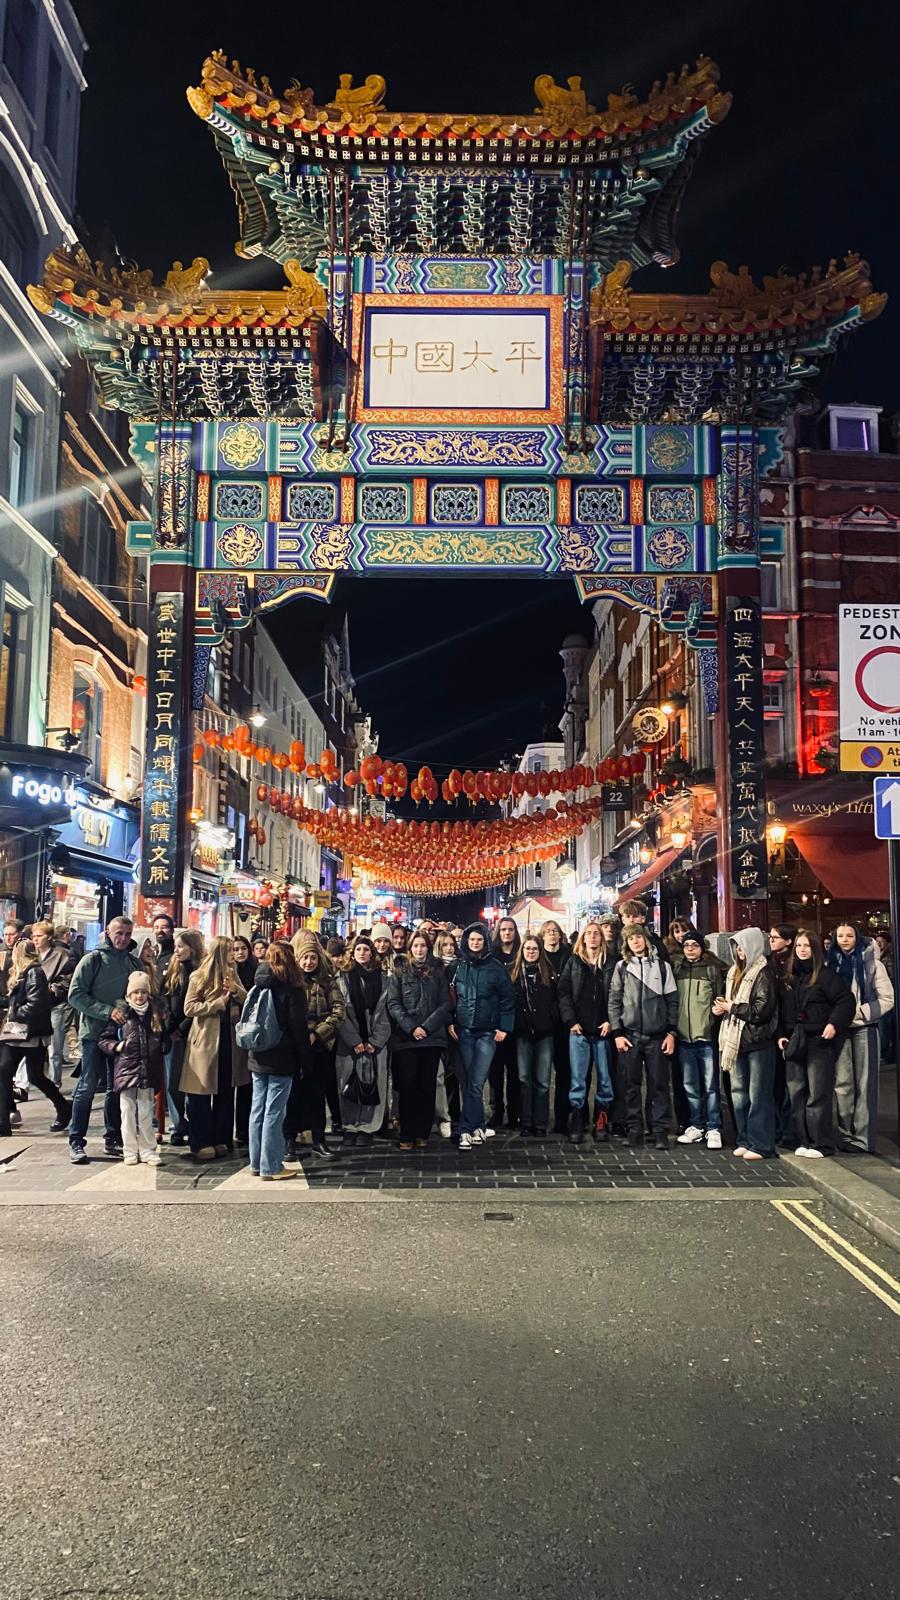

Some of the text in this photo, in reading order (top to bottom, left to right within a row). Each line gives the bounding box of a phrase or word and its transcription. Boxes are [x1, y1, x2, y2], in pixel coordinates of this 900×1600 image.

[373, 337, 543, 375] 中國太平
[843, 608, 900, 619] PEDEST
[860, 624, 900, 640] ZON
[860, 717, 875, 726] No
[894, 728, 900, 737] 1
[12, 775, 62, 805] Fogo
[609, 792, 623, 802] 22
